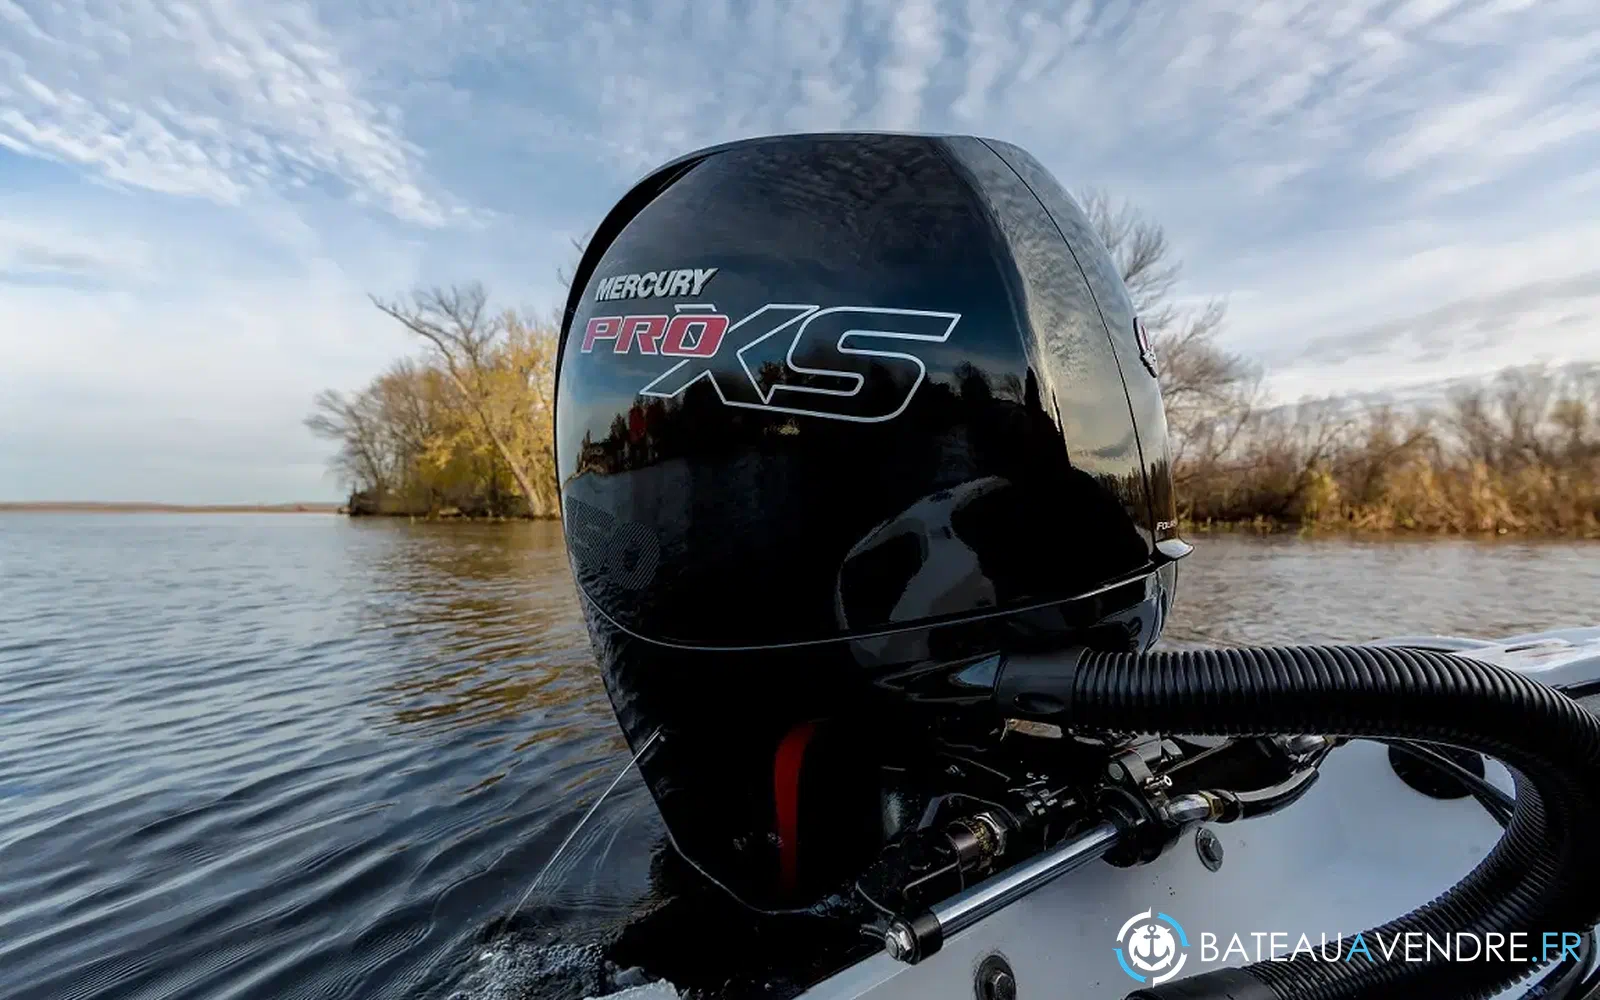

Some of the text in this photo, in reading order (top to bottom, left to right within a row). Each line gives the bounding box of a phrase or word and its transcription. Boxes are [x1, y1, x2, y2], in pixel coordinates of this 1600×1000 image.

[594, 267, 719, 301] MERCURY
[580, 302, 962, 423] PRO XS
